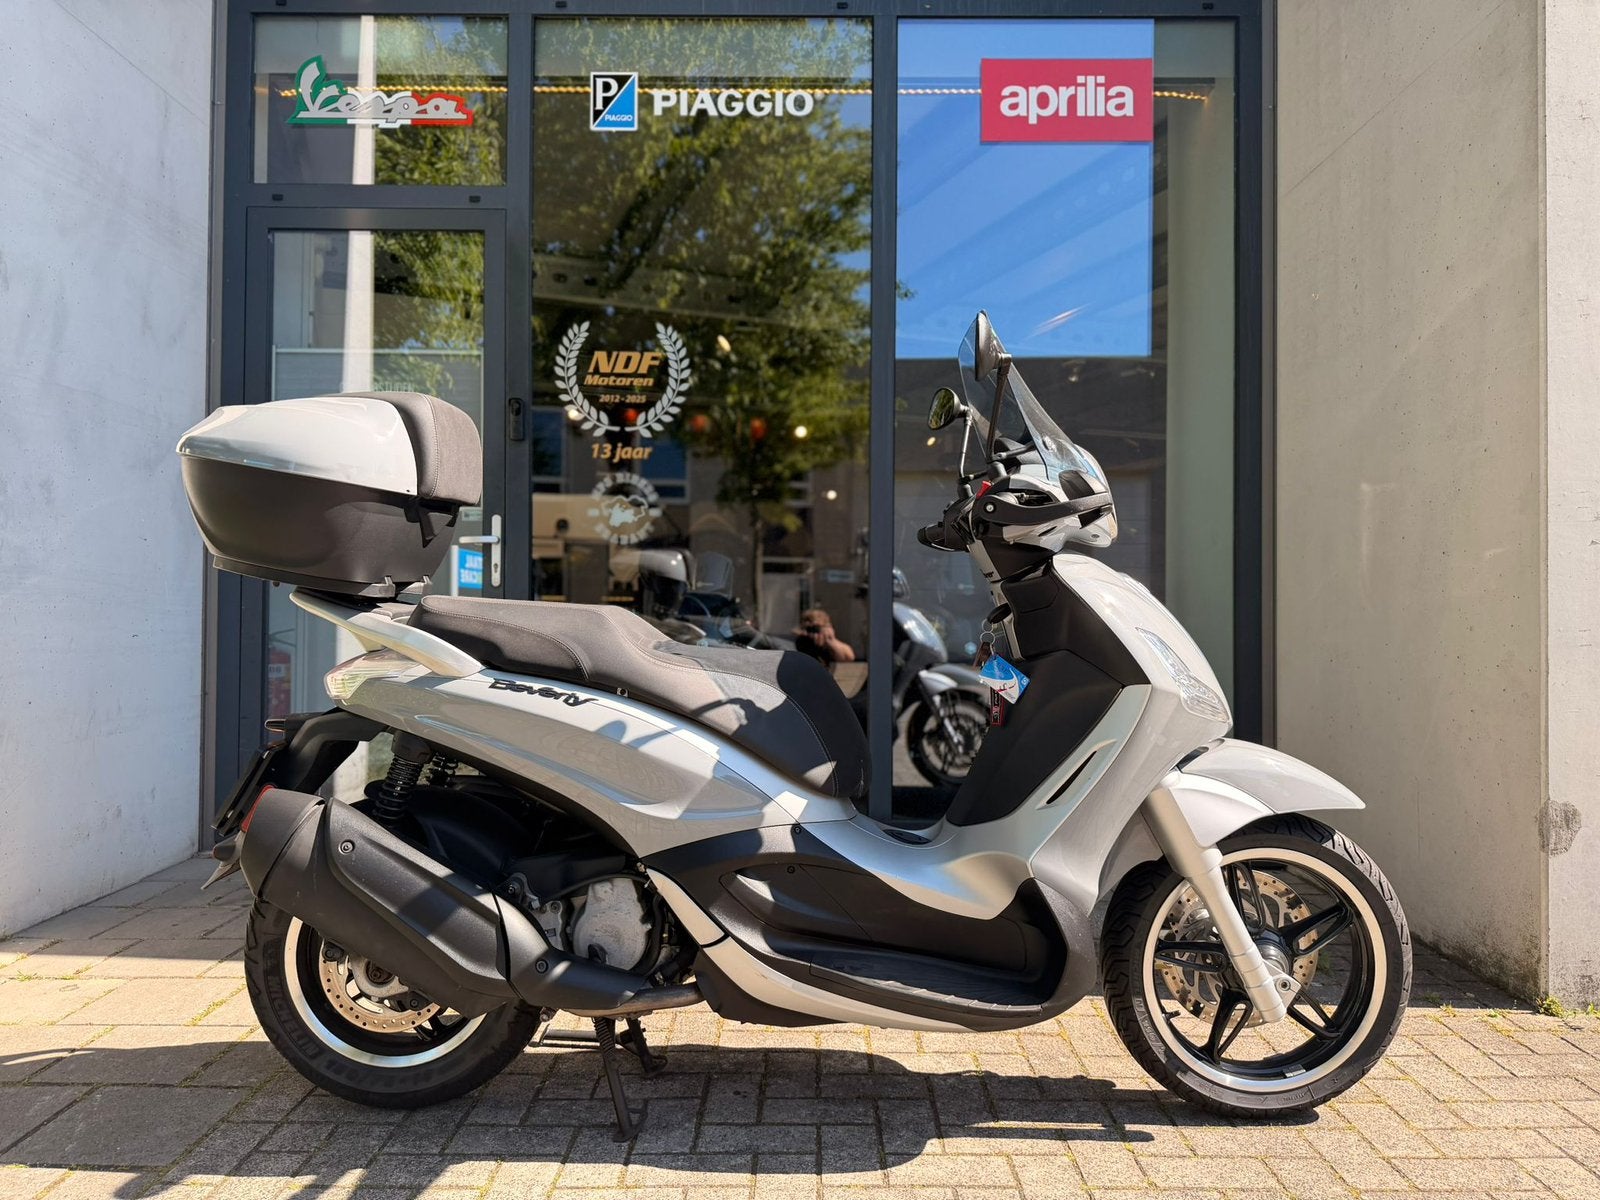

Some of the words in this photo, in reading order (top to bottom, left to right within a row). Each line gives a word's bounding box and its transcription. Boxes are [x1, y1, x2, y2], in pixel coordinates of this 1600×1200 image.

[295, 60, 470, 124] Vespa
[594, 77, 618, 110] P
[651, 88, 814, 117] PIAGGIO
[1000, 75, 1134, 125] aprilia
[604, 114, 633, 122] PIAGGIO
[588, 350, 662, 374] NDF
[583, 374, 655, 387] Motoren
[599, 394, 620, 404] 2012
[591, 442, 612, 459] 13
[613, 442, 653, 463] jaar
[488, 677, 599, 707] Beverly
